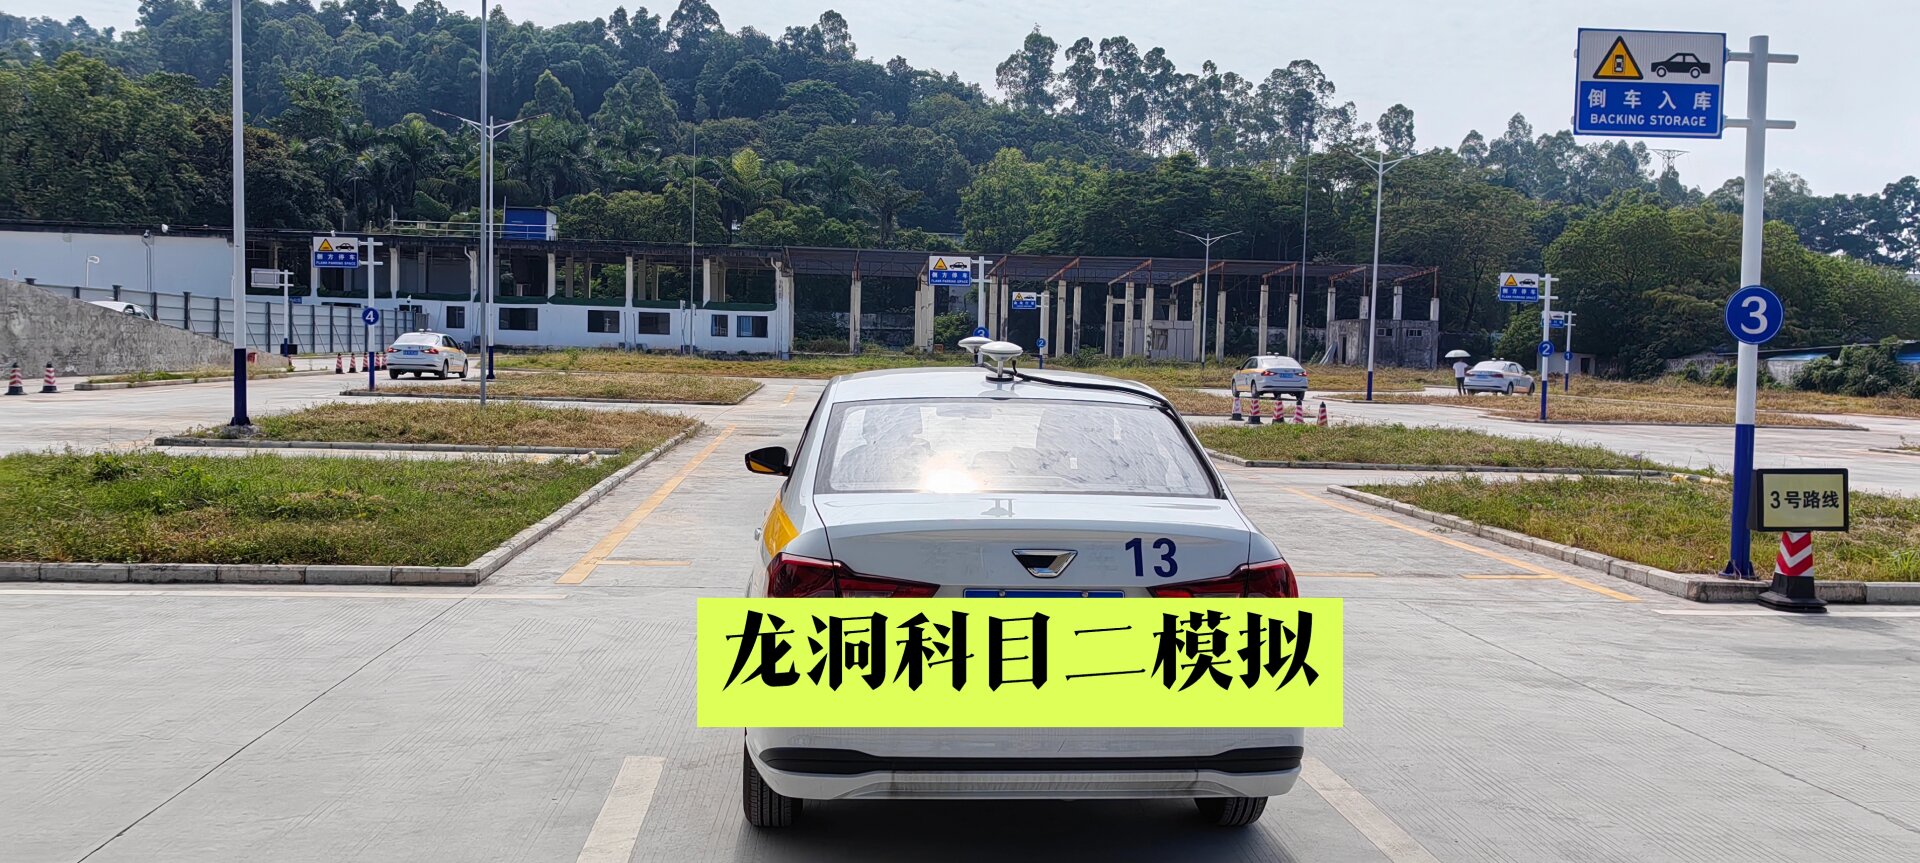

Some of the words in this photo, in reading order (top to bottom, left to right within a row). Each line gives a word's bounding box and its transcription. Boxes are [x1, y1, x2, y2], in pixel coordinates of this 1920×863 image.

[1588, 88, 1712, 111] 倒车入库
[1590, 113, 1645, 125] BACKING
[1650, 115, 1706, 127] STORAGE
[365, 310, 375, 323] 4
[1740, 296, 1768, 335] 3
[1542, 343, 1551, 355] 2
[1769, 489, 1840, 511] 3号路线
[1124, 537, 1179, 579] 13
